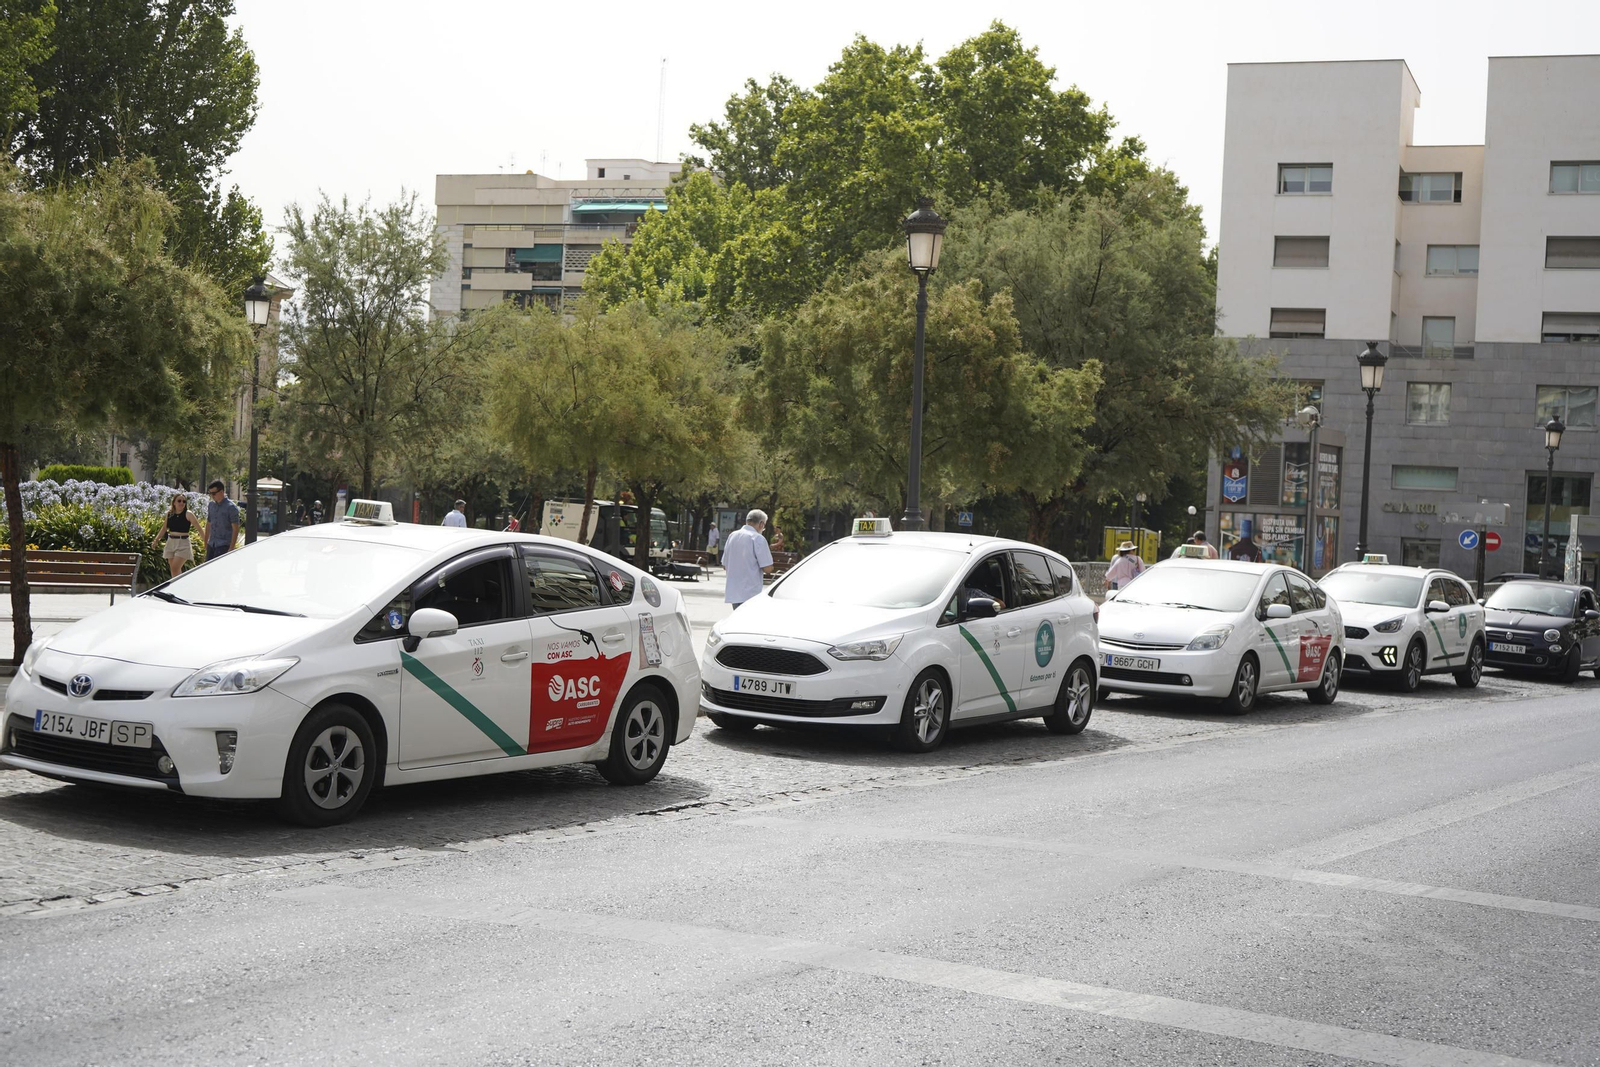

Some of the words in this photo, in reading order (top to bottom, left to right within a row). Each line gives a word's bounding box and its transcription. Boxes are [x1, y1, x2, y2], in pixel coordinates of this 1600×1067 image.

[356, 502, 374, 519] TAXI
[859, 521, 875, 531] TAXI
[1262, 518, 1285, 526] DISFRUTA
[1262, 533, 1271, 541] TUS
[468, 638, 485, 647] TAXI
[547, 643, 560, 651] NOS
[561, 640, 581, 649] VAMOS
[1494, 643, 1511, 652] 7152
[1511, 645, 1524, 653] LTR
[474, 647, 484, 655] 112
[547, 652, 560, 660] CON
[561, 650, 573, 659] ASC
[1310, 645, 1322, 658] ASC
[1113, 656, 1135, 667] 9667
[1137, 659, 1155, 670] GCH
[564, 675, 600, 700] ASC
[741, 678, 767, 692] 4789
[771, 682, 792, 695] JTW
[41, 713, 74, 735] 2154
[80, 720, 108, 739] JBF
[117, 725, 147, 744] SP
